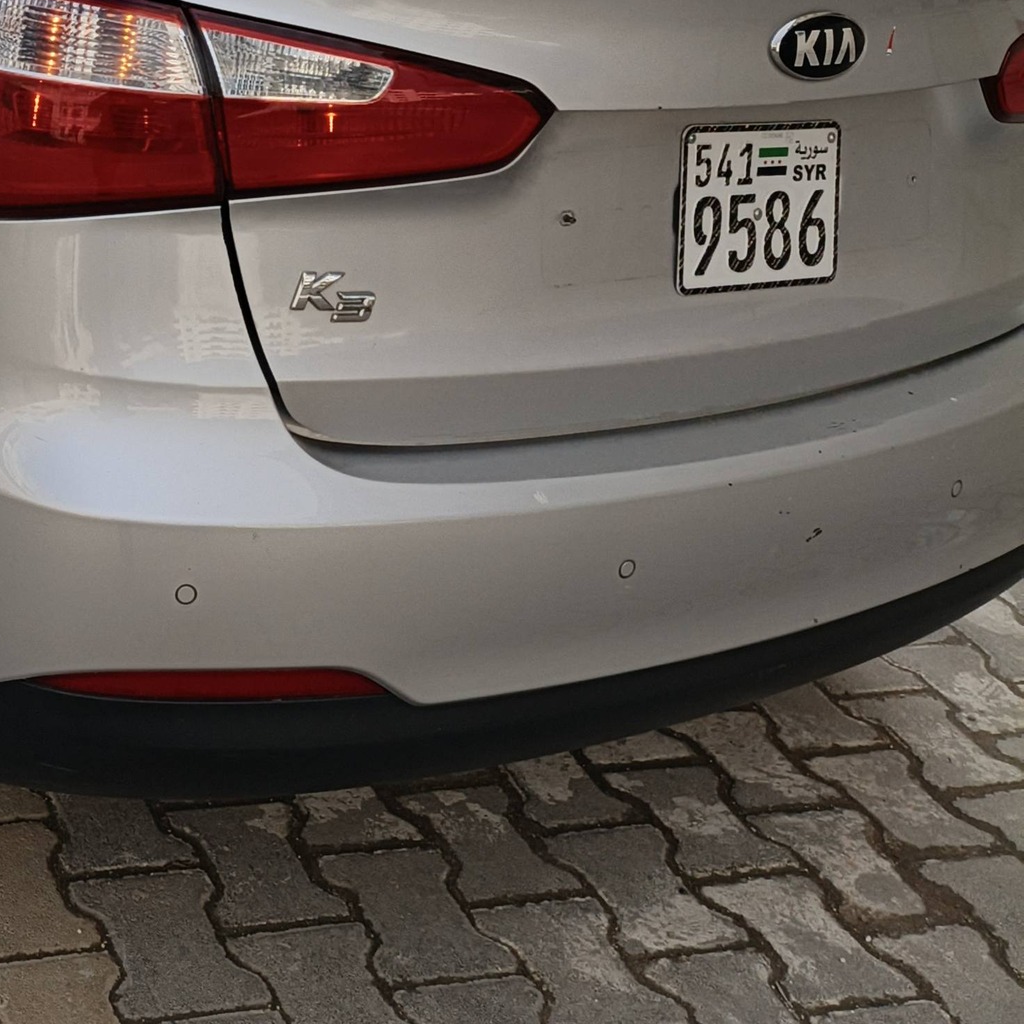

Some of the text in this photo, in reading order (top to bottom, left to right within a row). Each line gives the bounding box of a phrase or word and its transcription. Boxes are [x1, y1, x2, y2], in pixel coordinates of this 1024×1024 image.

[794, 28, 856, 67] KIA
[695, 143, 753, 187] 541
[795, 141, 829, 159] سورية
[792, 164, 827, 181] SYR
[694, 189, 826, 276] 9586
[290, 271, 376, 323] K3
